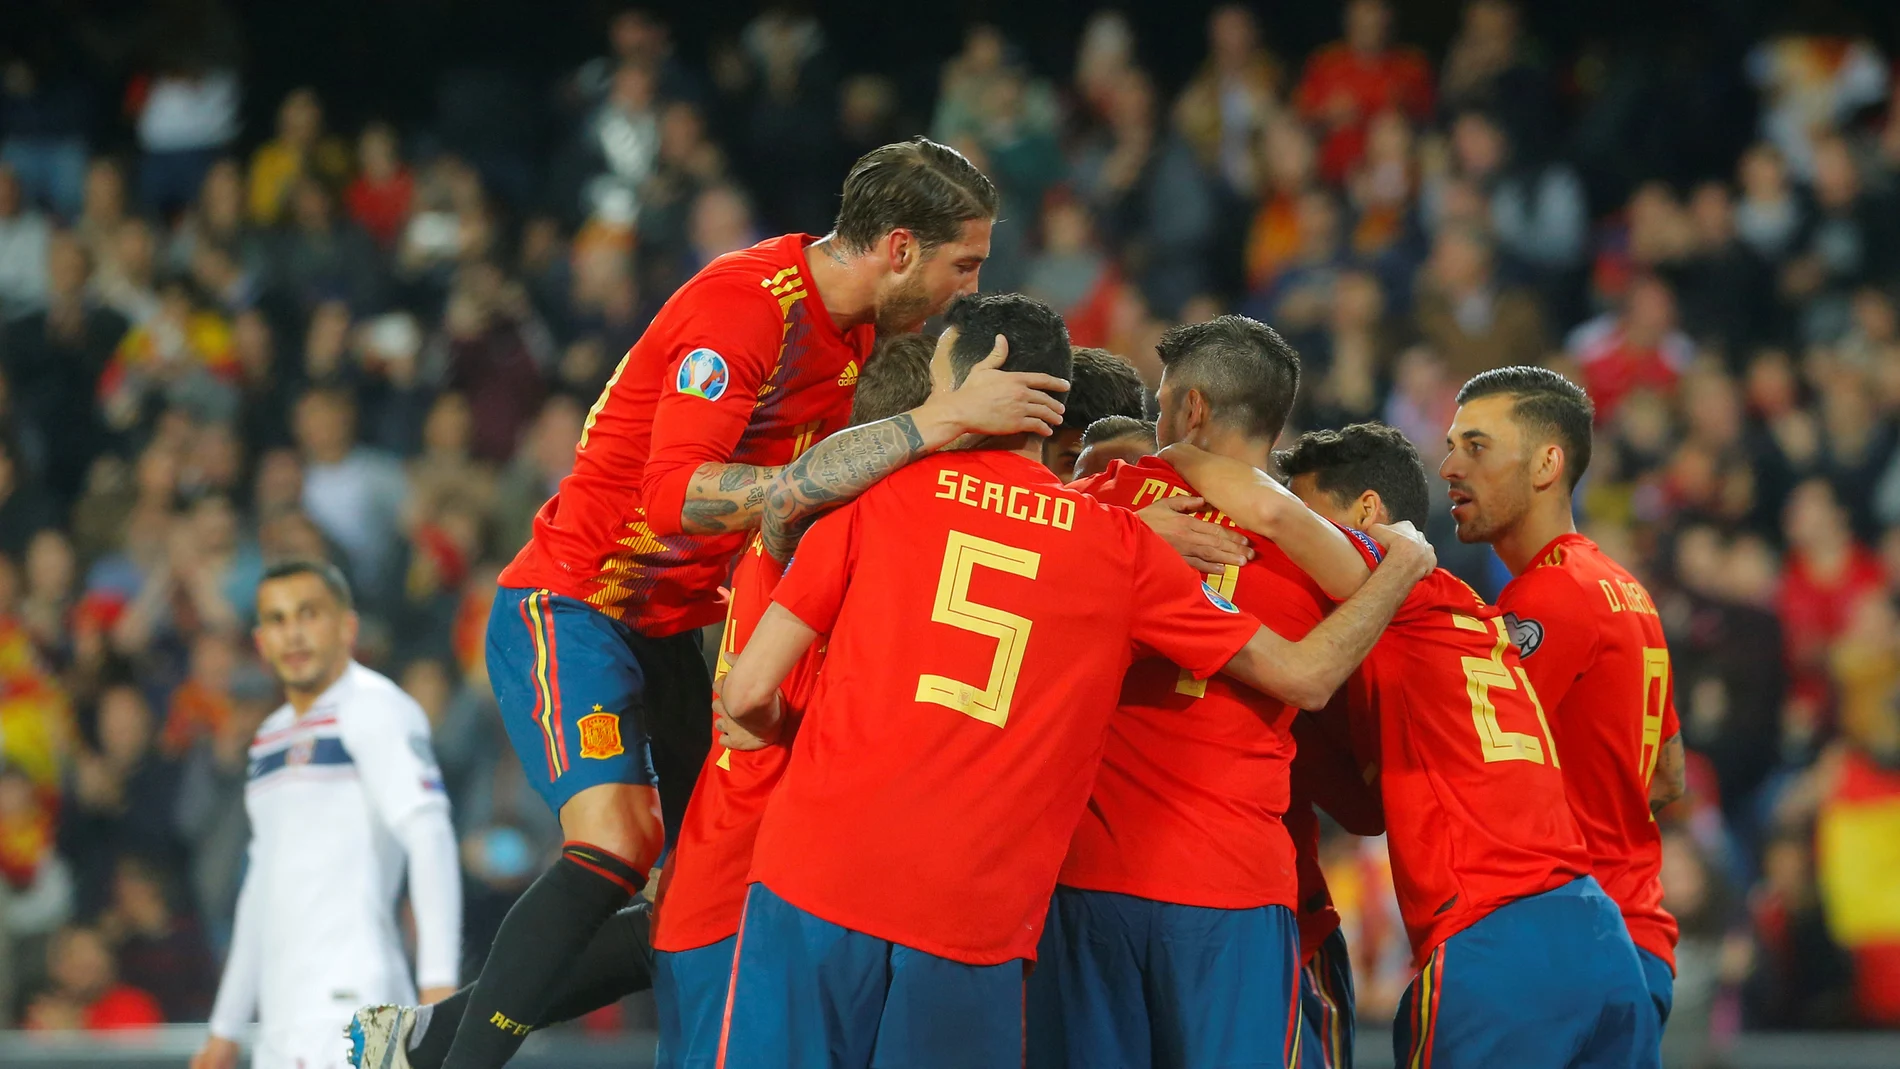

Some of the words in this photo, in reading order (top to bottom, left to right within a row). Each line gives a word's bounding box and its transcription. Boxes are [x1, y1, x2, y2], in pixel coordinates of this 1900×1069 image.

[935, 469, 1075, 531] SERGIO
[1598, 579, 1626, 613] D.
[915, 529, 1042, 729] 5
